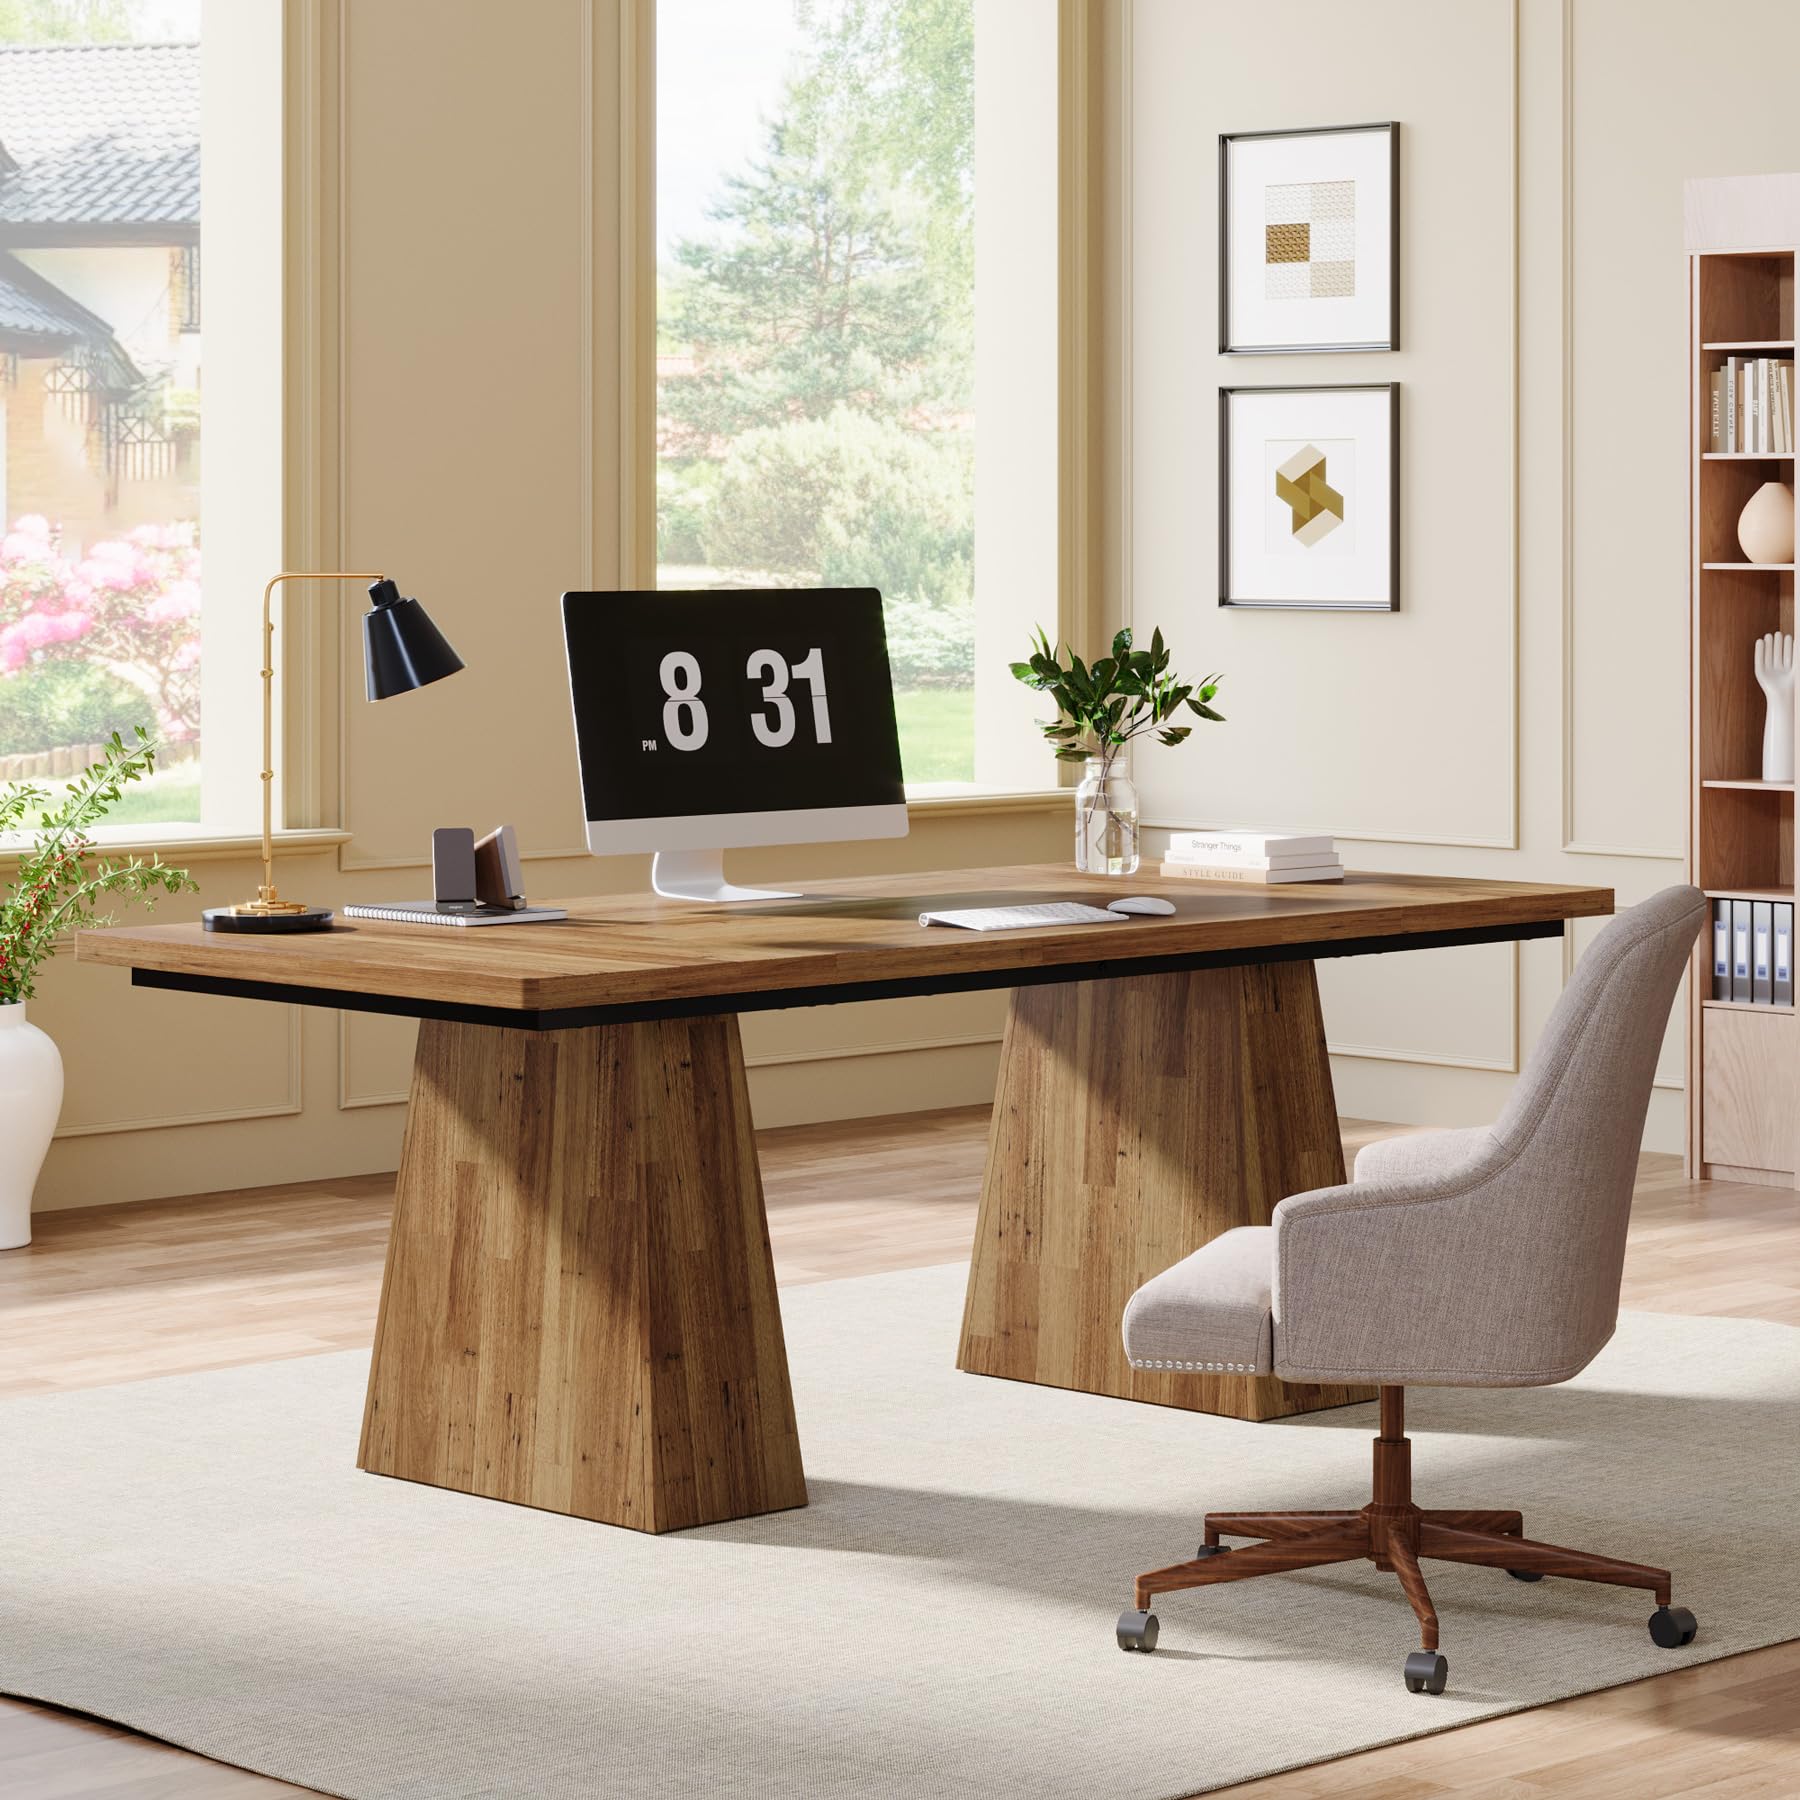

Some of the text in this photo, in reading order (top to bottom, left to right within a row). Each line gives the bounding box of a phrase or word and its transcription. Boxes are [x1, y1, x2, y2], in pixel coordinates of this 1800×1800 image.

[642, 648, 832, 751] PM 8 31
[1192, 840, 1241, 852] Stranger Things
[1183, 869, 1244, 880] STYLE GUIDE
